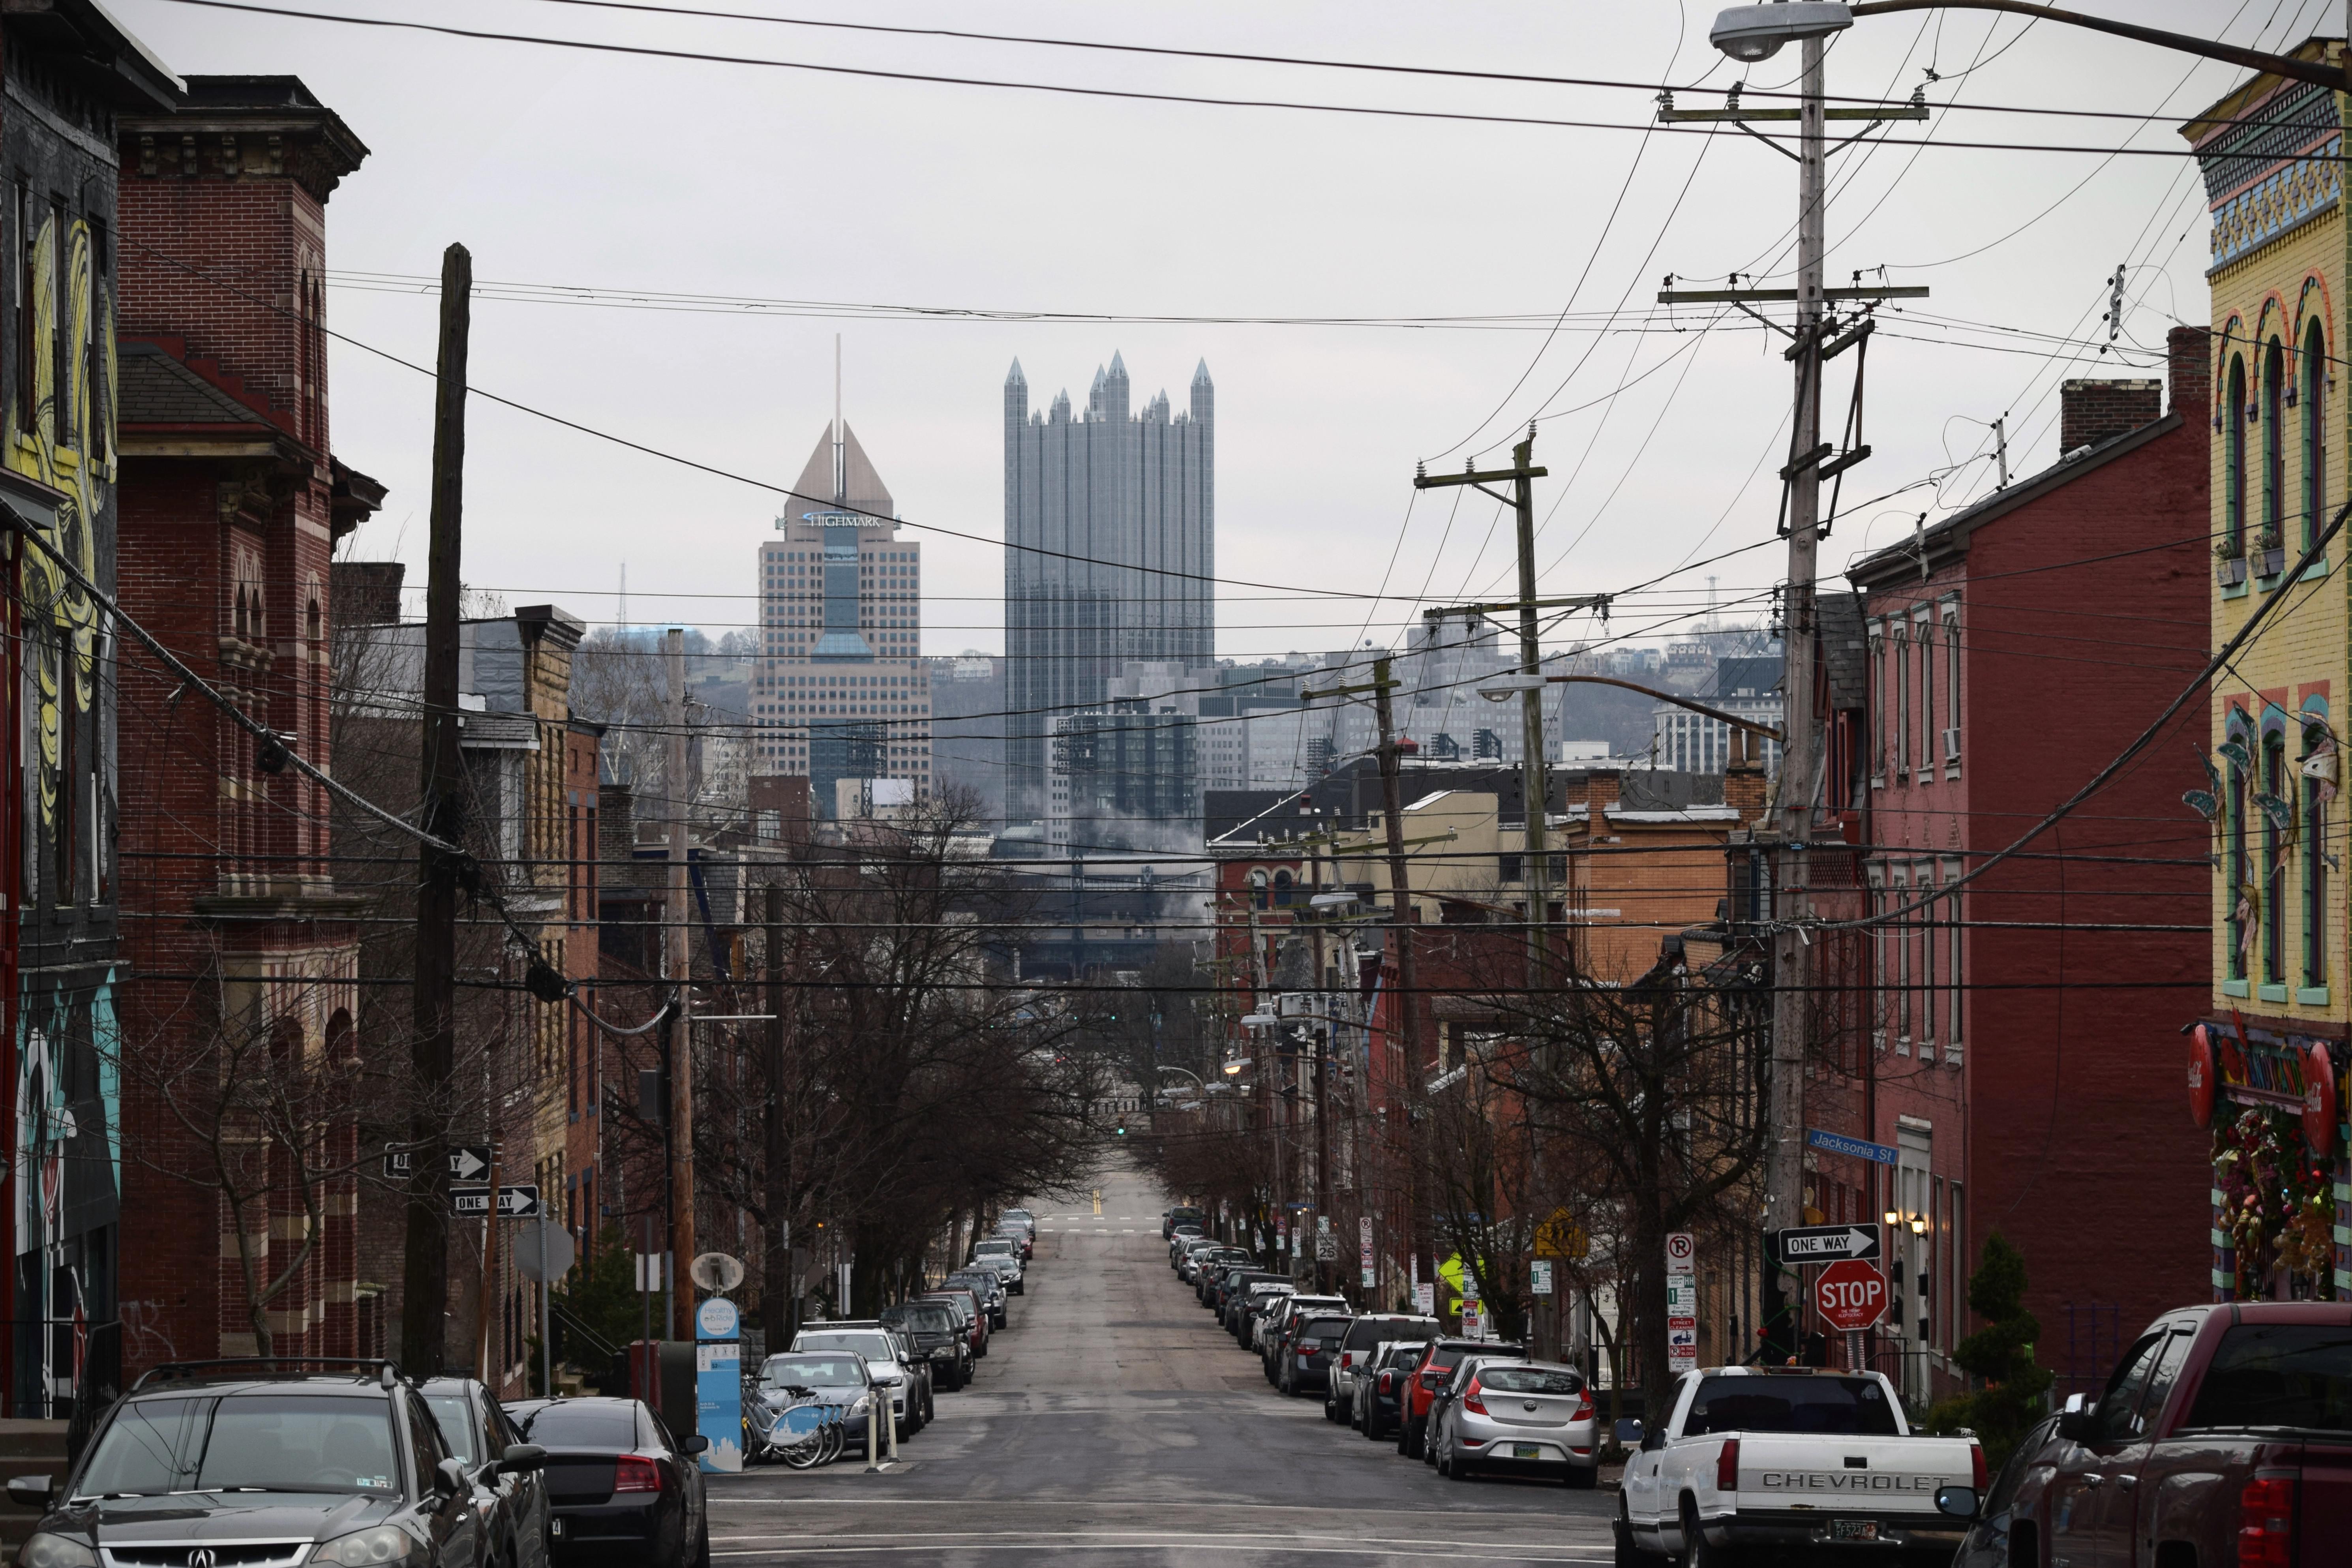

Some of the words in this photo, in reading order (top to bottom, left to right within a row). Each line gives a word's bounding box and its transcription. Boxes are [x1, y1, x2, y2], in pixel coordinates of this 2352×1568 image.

[811, 515, 881, 527] HIGHMARK
[1814, 1133, 1874, 1157] Jacksonia
[1878, 1148, 1892, 1161] St
[459, 1197, 481, 1209] ONE
[1791, 1238, 1818, 1252] ONE
[1823, 1236, 1849, 1250] WAY
[1319, 1247, 1334, 1257] 25
[1534, 1272, 1537, 1283] 1
[1685, 1276, 1694, 1286] HH
[1671, 1289, 1674, 1303] 1
[1821, 1281, 1881, 1308] STOP
[1763, 1472, 1950, 1491] CHEVROLET
